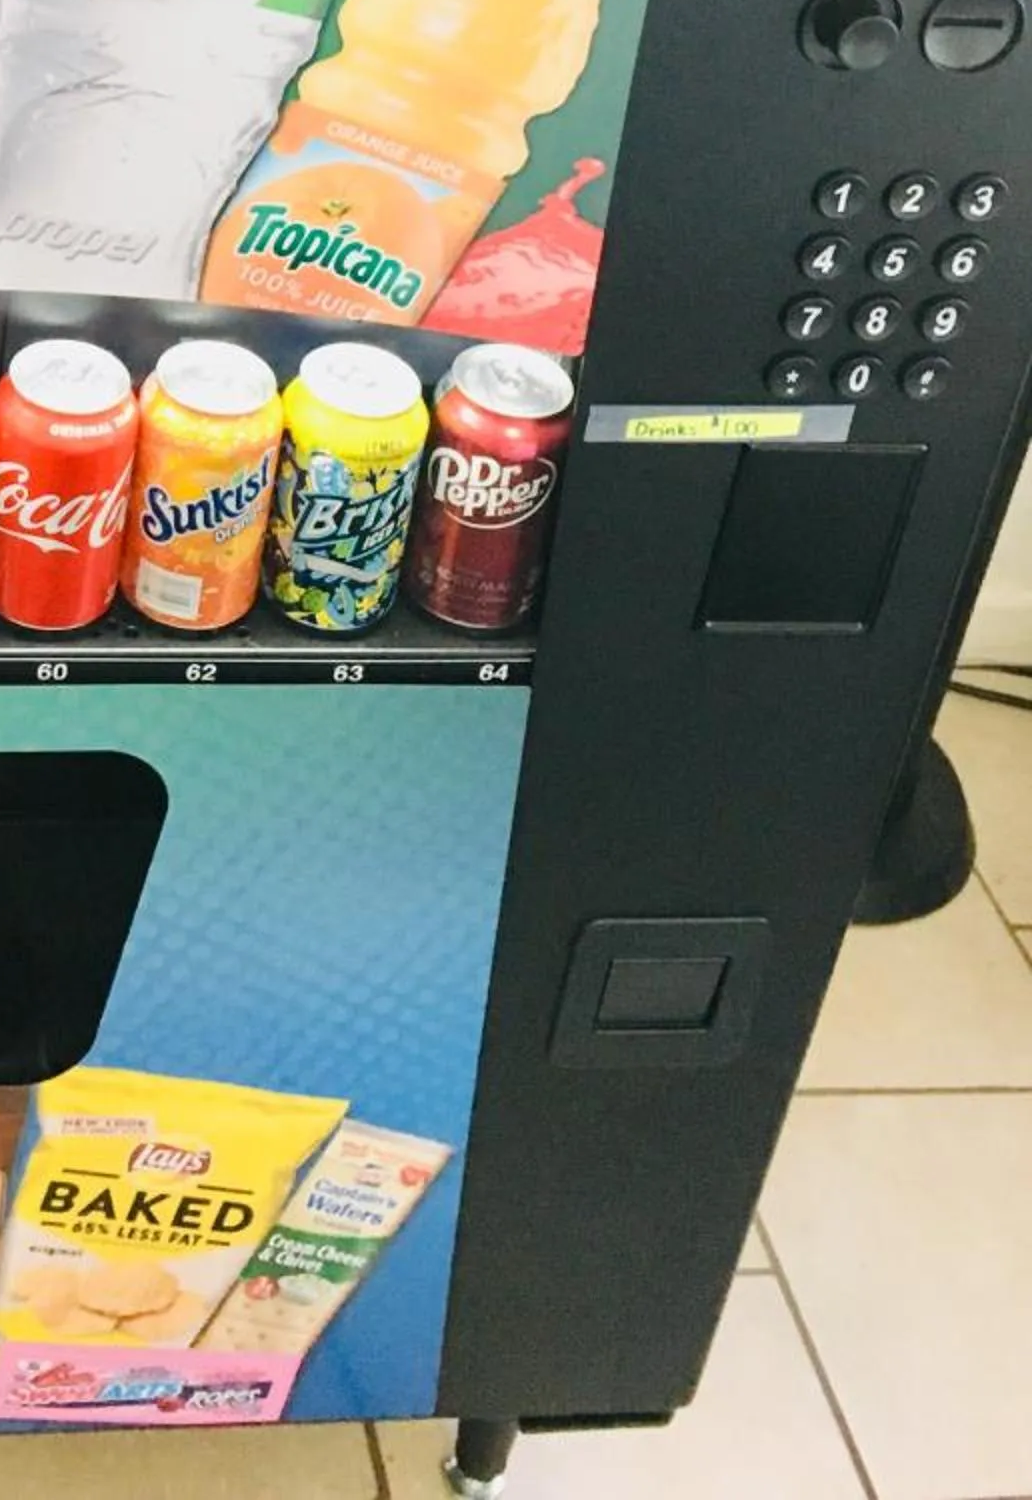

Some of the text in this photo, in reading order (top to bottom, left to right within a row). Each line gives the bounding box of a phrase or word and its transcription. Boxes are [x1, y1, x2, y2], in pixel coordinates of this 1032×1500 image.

[326, 120, 410, 159] ORANGE
[833, 182, 851, 213] 1
[901, 184, 926, 213] 2
[969, 185, 995, 217] 3
[236, 203, 424, 308] Tropicana
[812, 244, 836, 274] 4
[883, 247, 908, 277] 5
[951, 247, 977, 277] 6
[237, 262, 304, 301] 100%
[801, 307, 822, 335] 7
[866, 306, 889, 336] 8
[933, 307, 958, 336] 9
[849, 364, 870, 392] 0
[434, 448, 550, 518] Pepper
[467, 455, 523, 489] Dr
[36, 663, 68, 681] 60
[185, 663, 217, 682] 62
[333, 663, 364, 682] 63
[478, 663, 509, 681] 64
[39, 1180, 255, 1234] BAKED
[306, 1192, 384, 1226] Wafers
[72, 1221, 204, 1247] 65% LESS FAT
